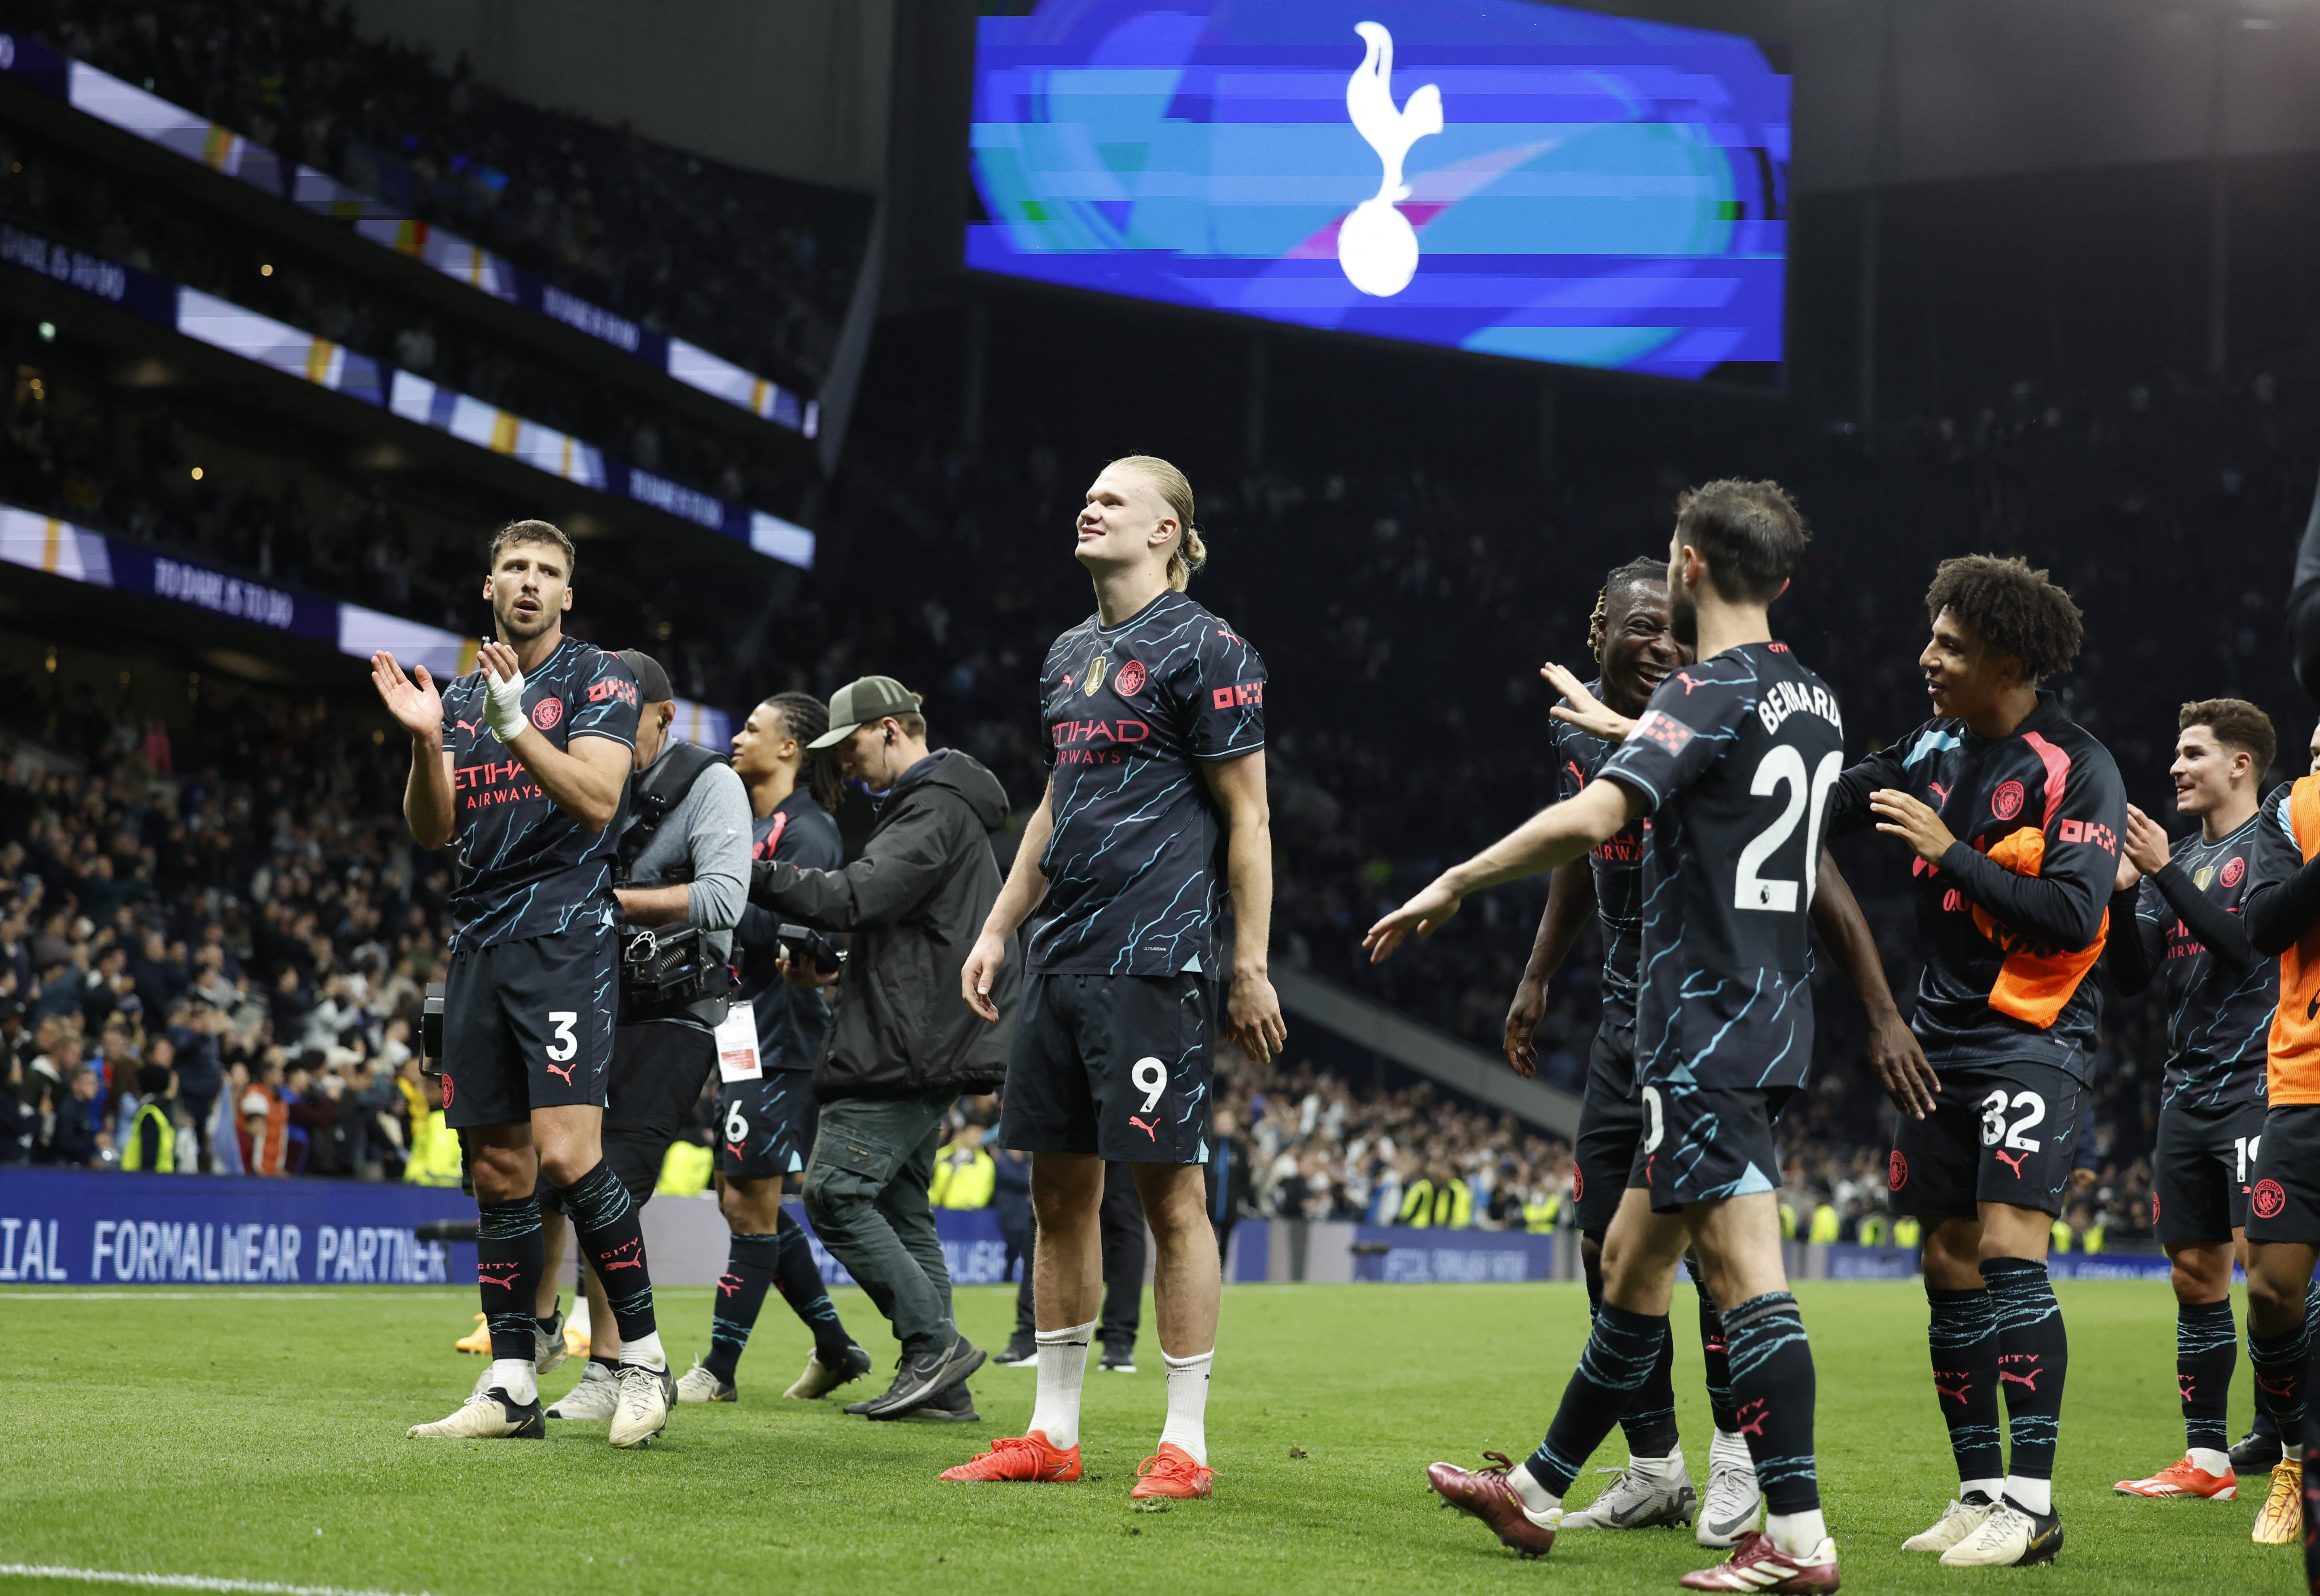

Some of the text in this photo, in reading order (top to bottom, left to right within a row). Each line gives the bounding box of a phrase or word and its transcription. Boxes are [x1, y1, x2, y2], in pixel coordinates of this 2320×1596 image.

[1122, 663, 1143, 675] MANCHESTER
[588, 679, 637, 705] OKX
[1213, 682, 1262, 710] OKX
[1758, 681, 1844, 741] BERNARD
[1055, 749, 1121, 765] IRWAYS
[467, 785, 542, 809] AIRWAYS
[2059, 819, 2116, 857] OKX
[546, 1011, 578, 1061] 3
[1132, 1057, 1167, 1112] 9
[725, 1100, 749, 1143] 6
[2256, 1182, 2281, 1195] MANCHESTER
[91, 1218, 301, 1282] FORMALWEAR
[601, 1237, 639, 1259] CITY
[1998, 1354, 2039, 1364] CITY
